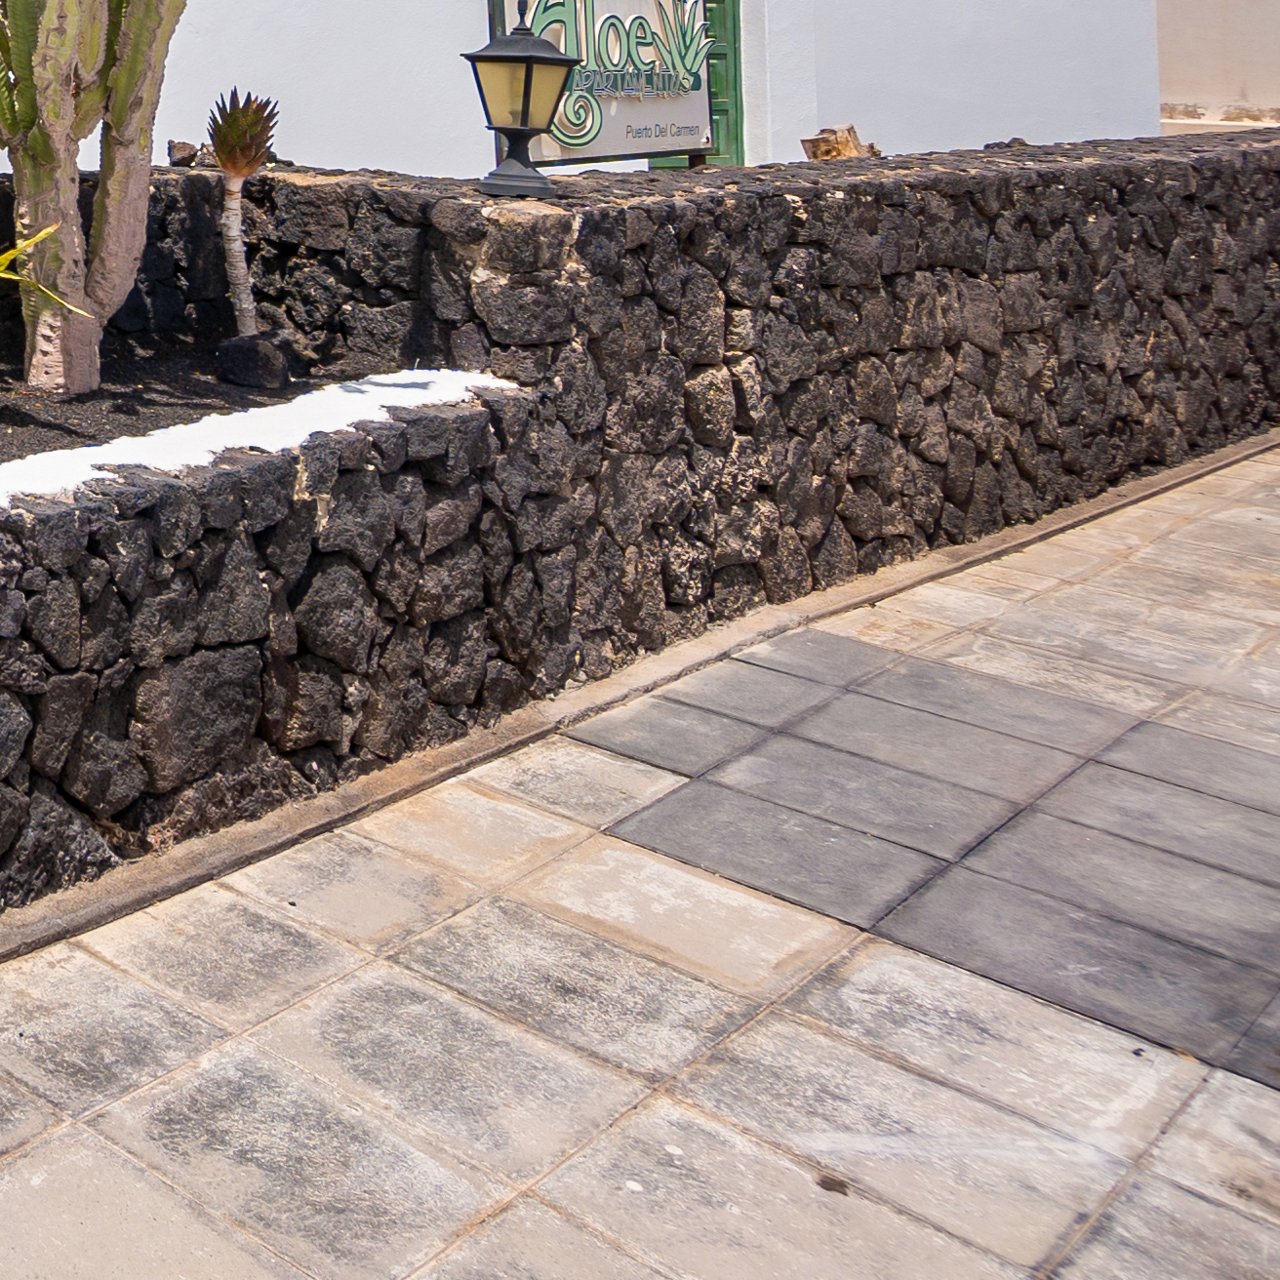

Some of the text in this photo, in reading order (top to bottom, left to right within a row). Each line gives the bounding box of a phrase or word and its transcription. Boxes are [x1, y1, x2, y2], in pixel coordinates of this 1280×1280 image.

[572, 68, 691, 97] APARTAMENTOS
[626, 123, 700, 139] Puerto Del Carmen
